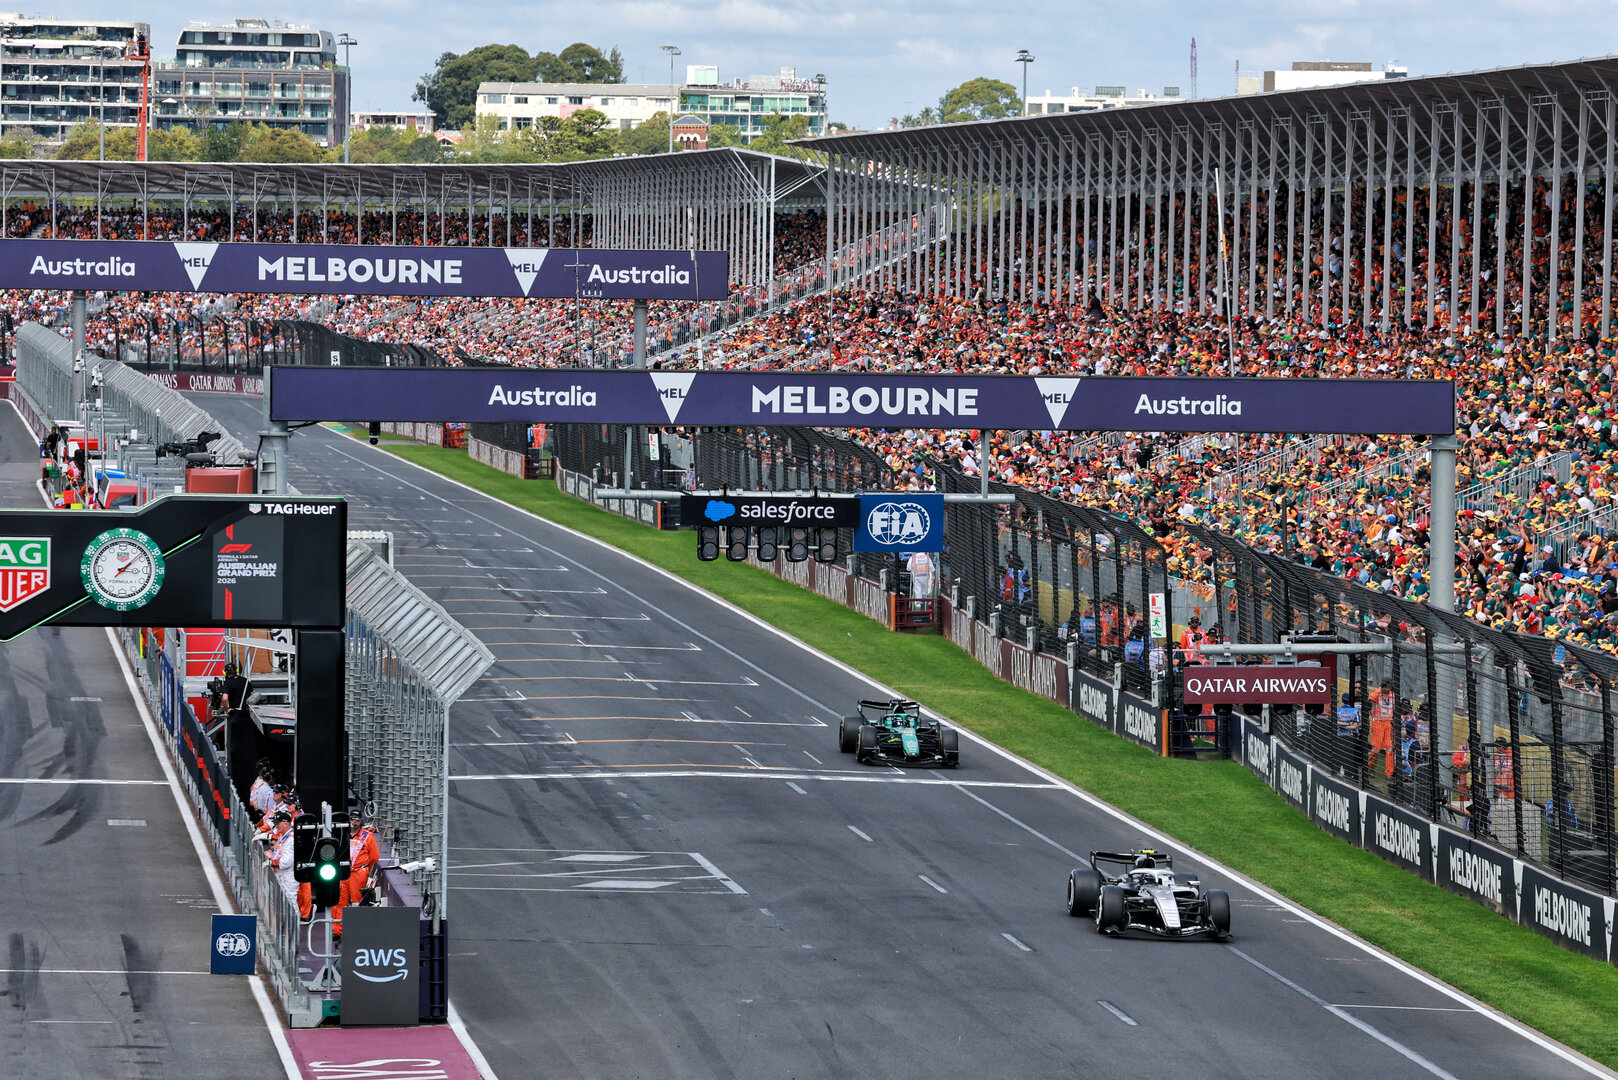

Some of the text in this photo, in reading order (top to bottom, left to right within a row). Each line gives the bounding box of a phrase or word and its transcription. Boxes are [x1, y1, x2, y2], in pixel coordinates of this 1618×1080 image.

[29, 255, 136, 277] Australia
[181, 257, 209, 268] MEL
[258, 255, 463, 285] MELBOURNE
[512, 263, 540, 273] MEL
[587, 264, 690, 285] Australia
[189, 375, 237, 392] QATAR AIRWAYS
[488, 384, 597, 407] Australia
[657, 387, 686, 399] MEL
[751, 384, 979, 417] MELBOURNE
[1042, 393, 1070, 404] MEL
[1134, 393, 1242, 416] Australia
[740, 501, 835, 523] salesforce
[98, 532, 110, 541] 55
[137, 532, 149, 542] 05
[84, 545, 95, 556] 50
[152, 547, 161, 556] 10
[80, 564, 88, 575] 45
[158, 567, 165, 575] 15
[217, 562, 277, 570] AUSTRALIAN
[217, 569, 276, 577] GRAND PRIX
[84, 583, 93, 593] 40
[151, 584, 161, 595] 20
[1186, 678, 1327, 696] QATAR AIRWAYS
[1079, 682, 1107, 722] MELBOURNE
[1124, 703, 1157, 745] MELBOURNE
[1316, 782, 1350, 832] MELBOURNE
[1375, 810, 1421, 866] MELBOURNE
[1449, 844, 1502, 904] MELBOURNE
[1534, 884, 1591, 947] MELBOURNE
[354, 948, 406, 967] aws
